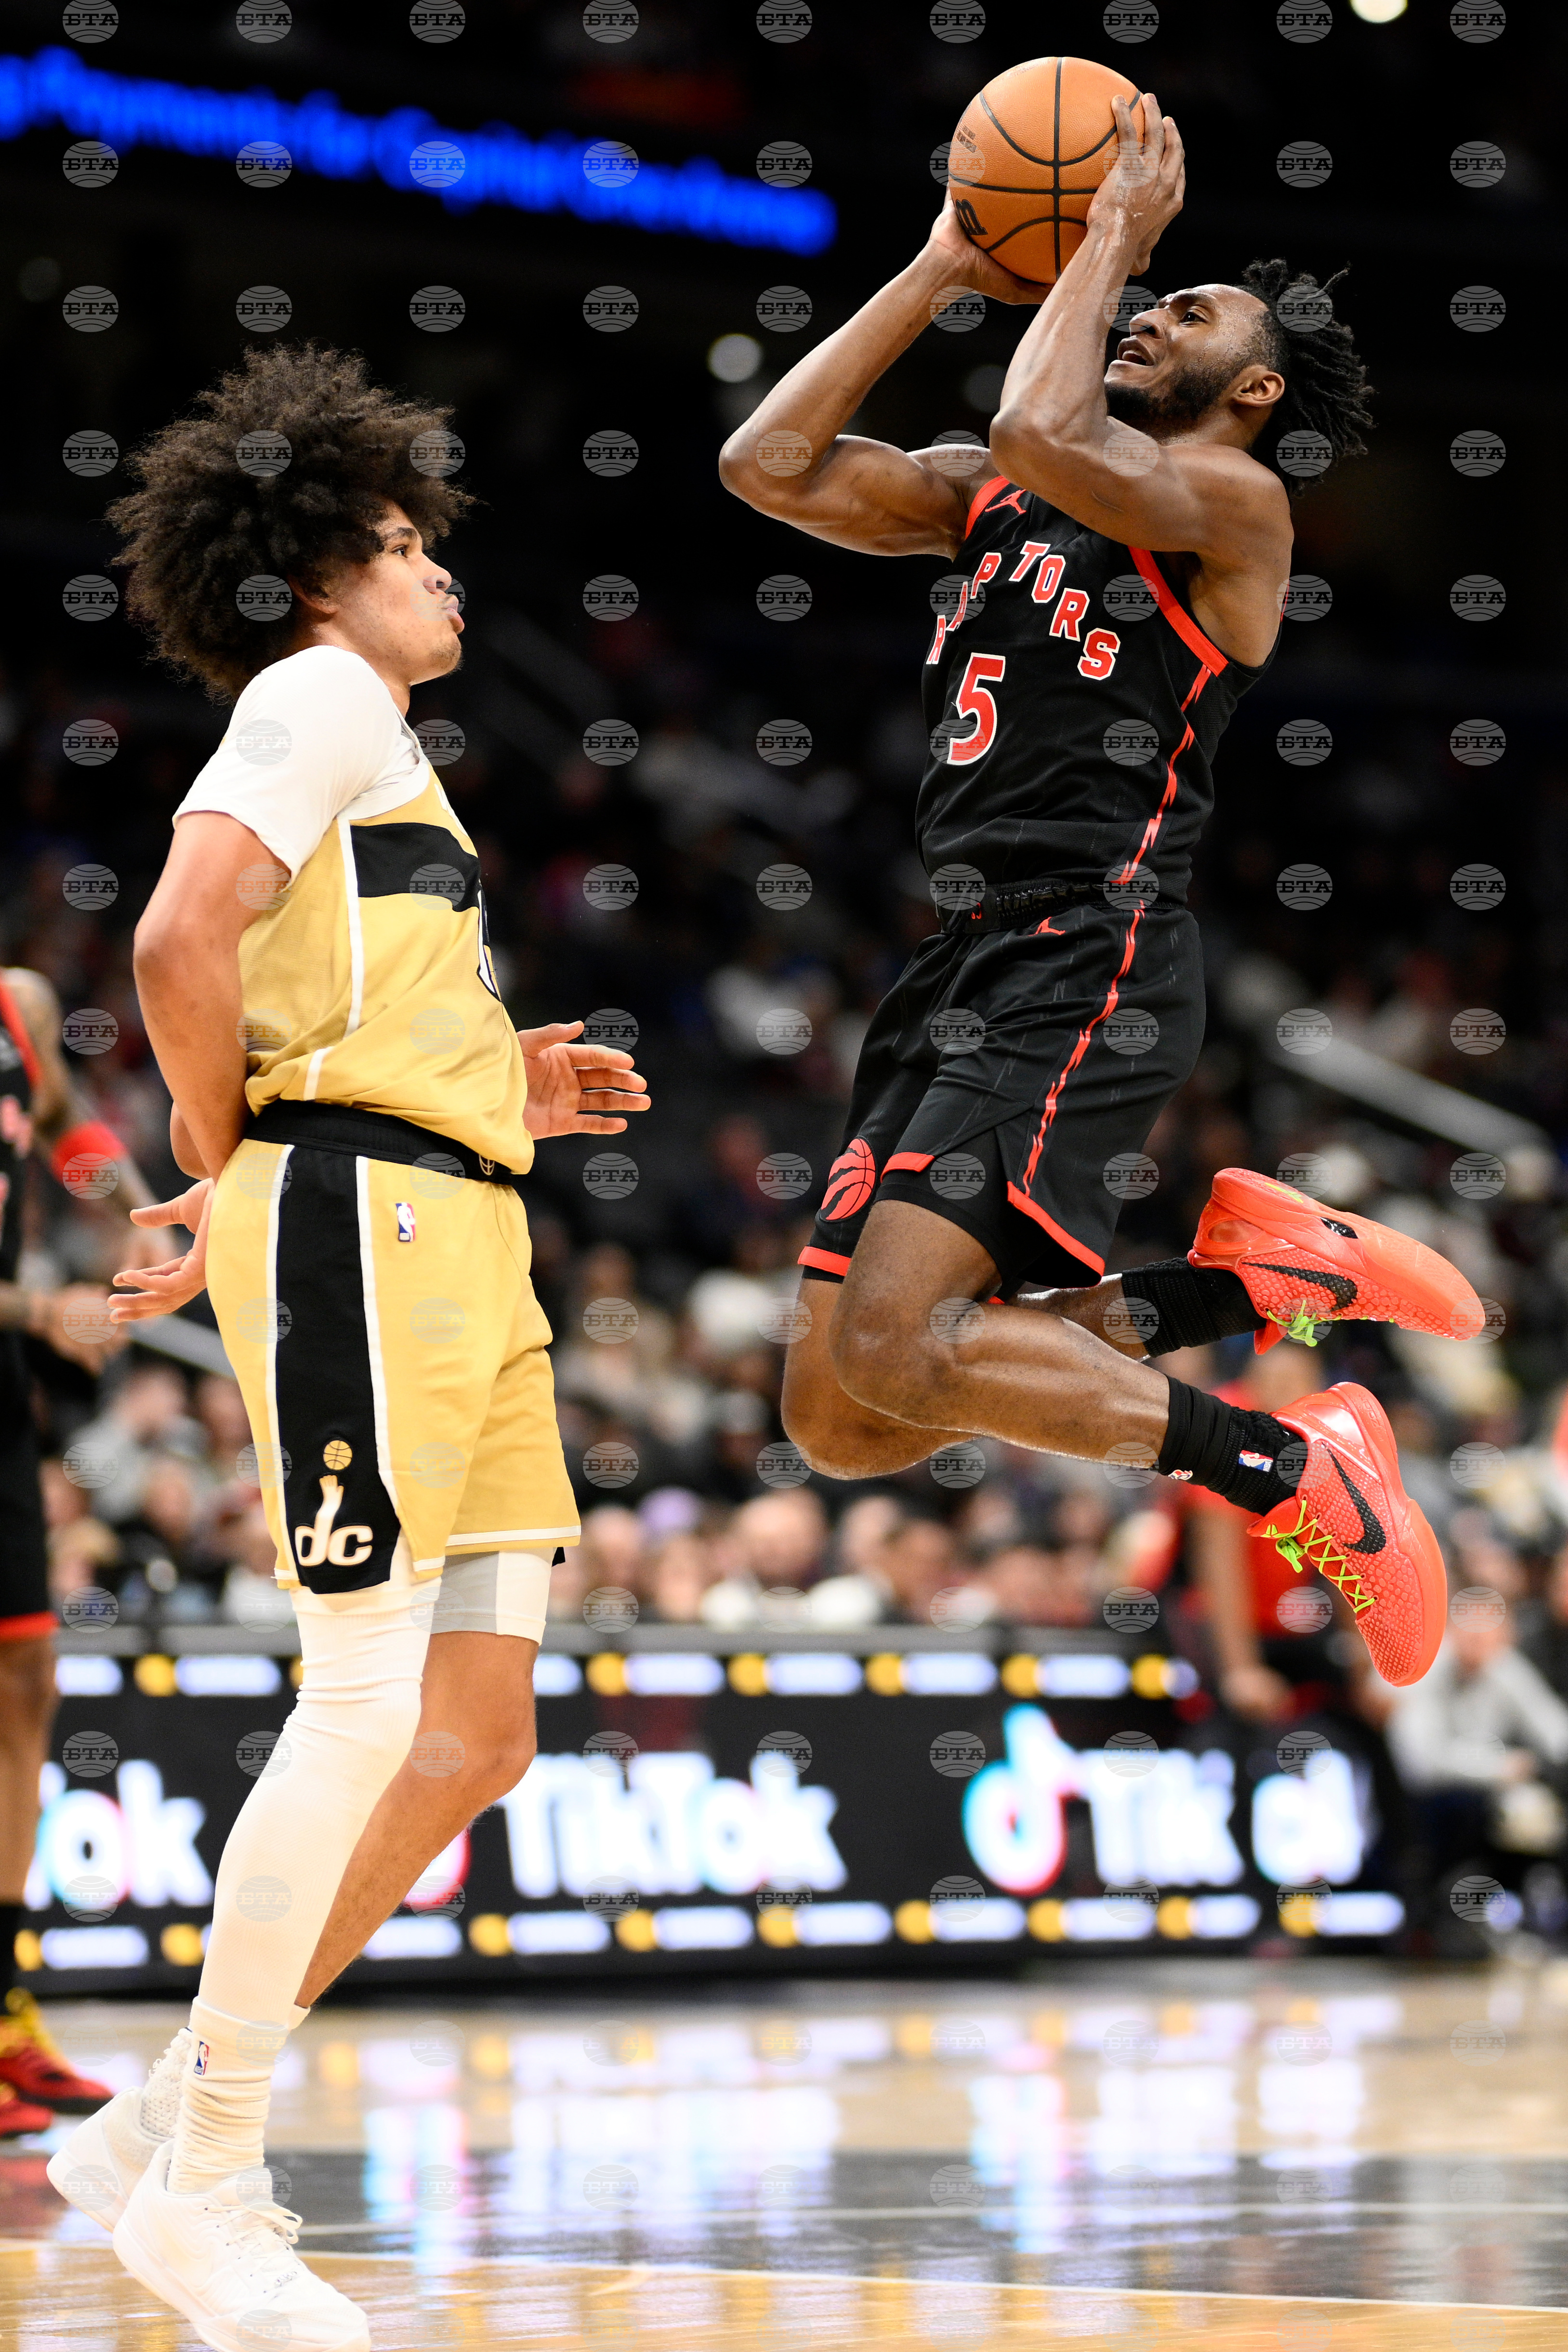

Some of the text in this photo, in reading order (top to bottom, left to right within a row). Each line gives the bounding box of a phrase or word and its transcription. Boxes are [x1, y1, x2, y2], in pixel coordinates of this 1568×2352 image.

[926, 541, 1120, 680] RAPTORS
[947, 652, 1005, 766] 5
[499, 1751, 848, 1899] TikTok
